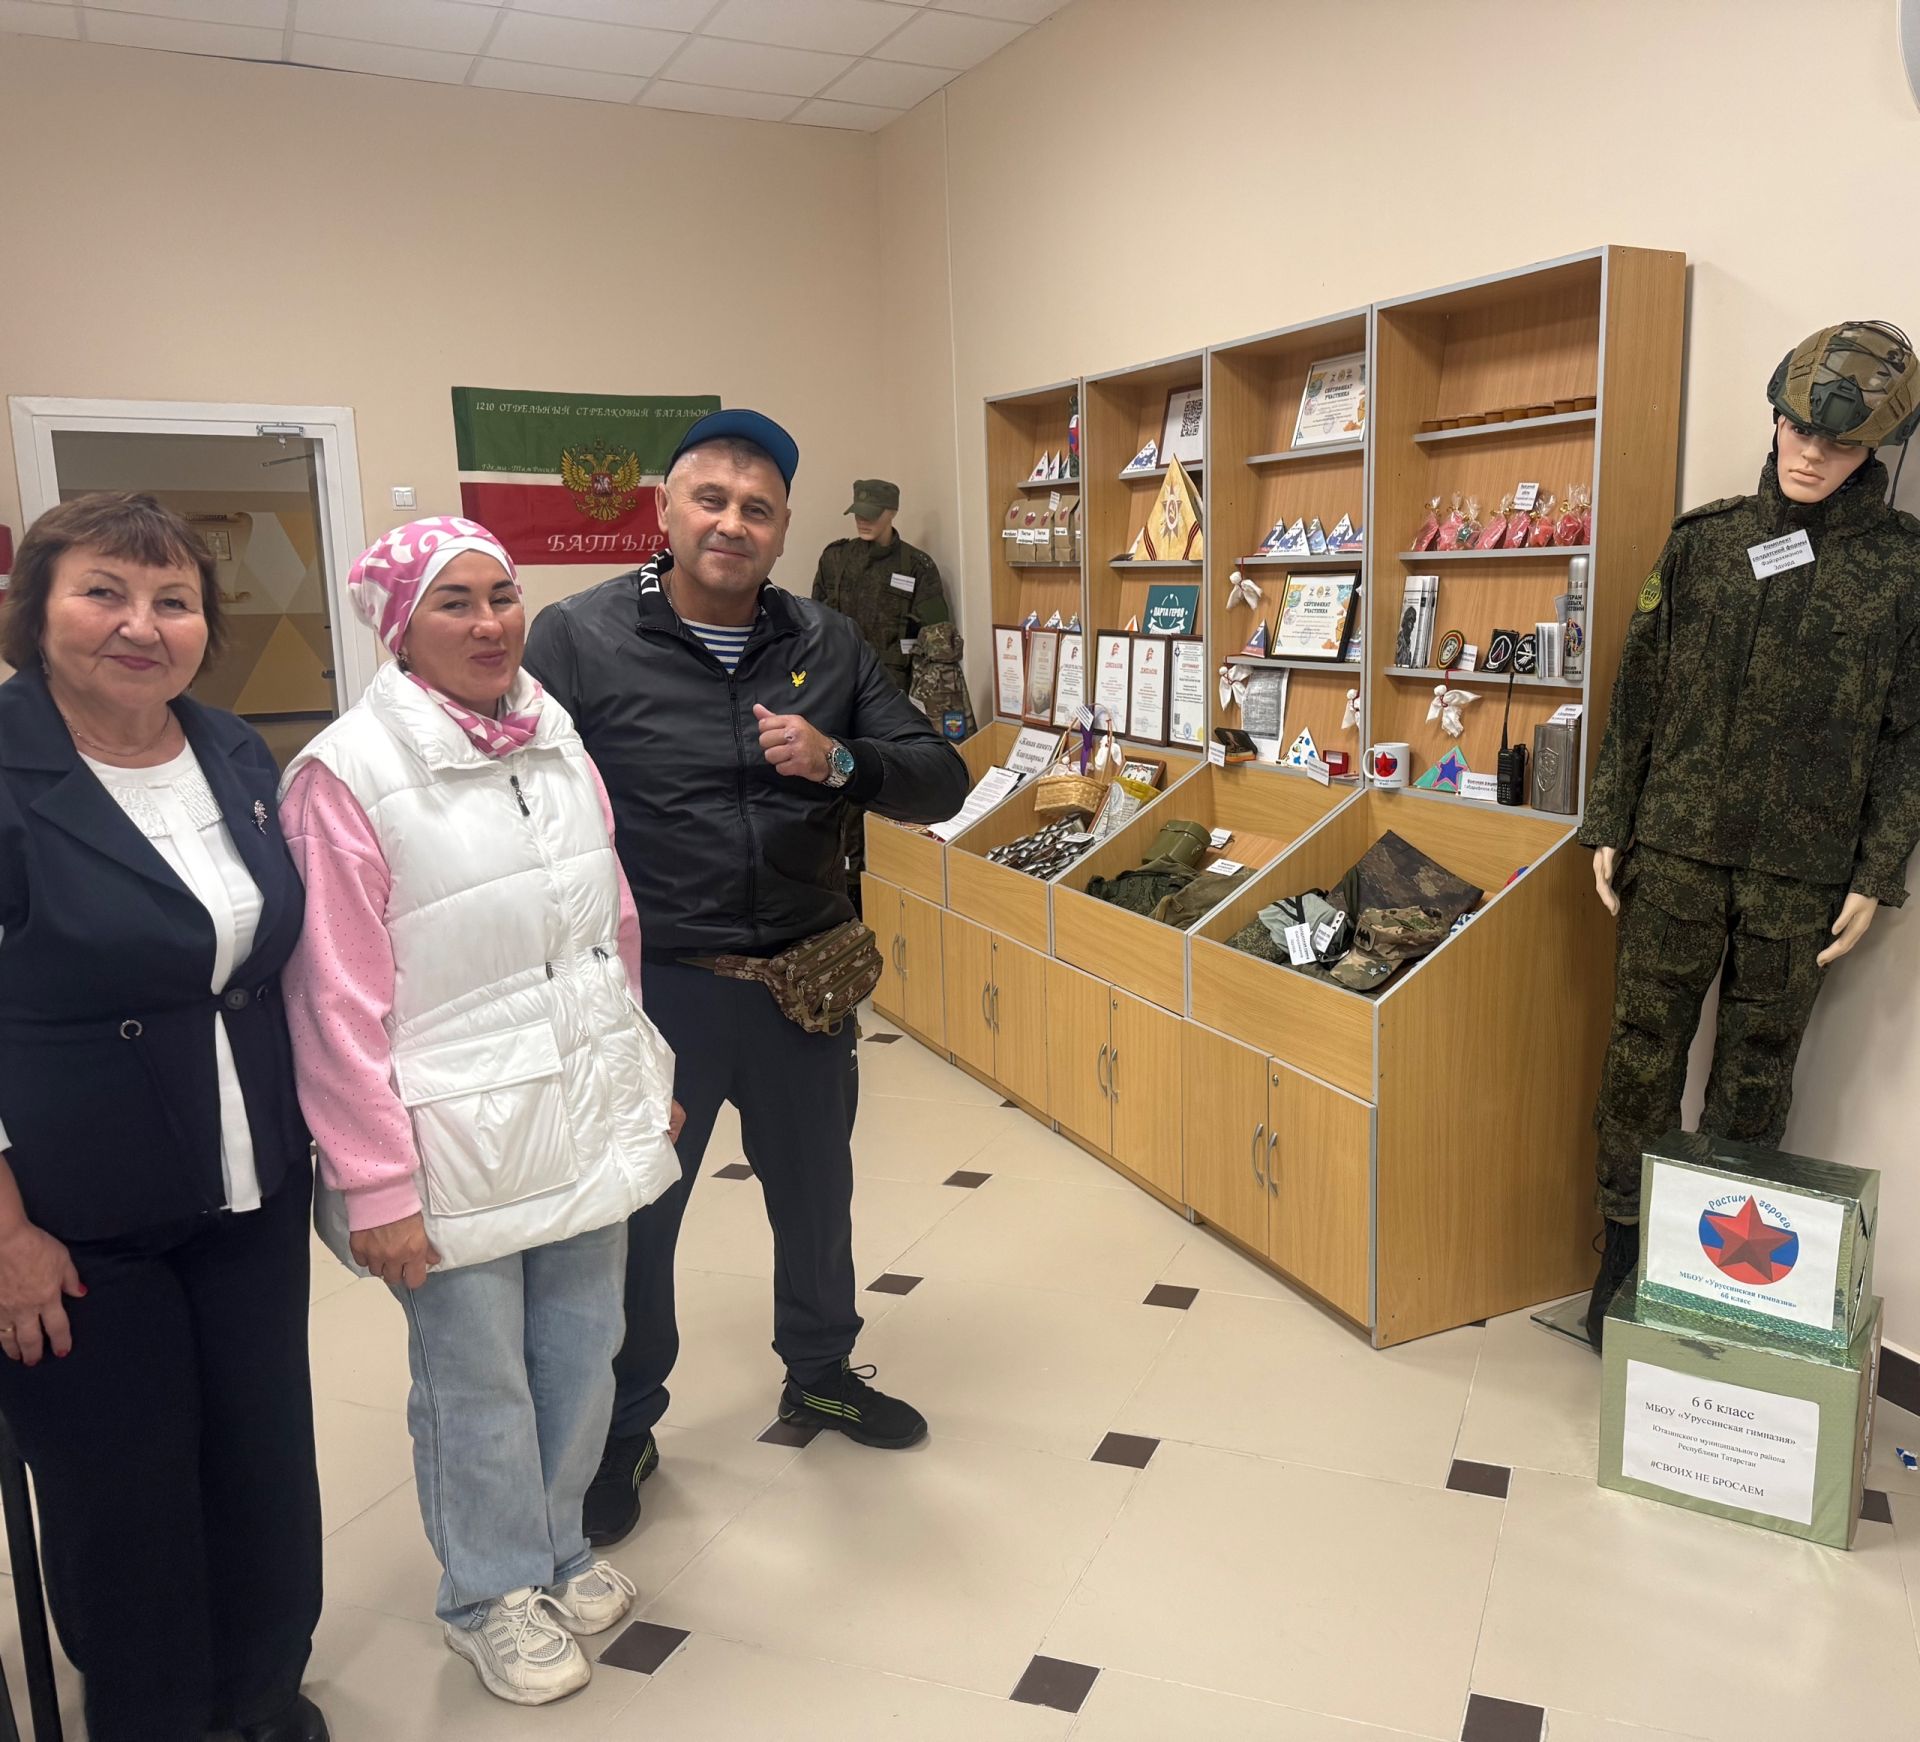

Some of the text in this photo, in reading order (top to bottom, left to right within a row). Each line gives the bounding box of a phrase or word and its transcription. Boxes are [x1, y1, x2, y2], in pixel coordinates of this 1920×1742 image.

[476, 402, 495, 411] 1210
[500, 403, 570, 415] ОТДЕЛЬНЫЙ
[576, 407, 649, 418] СТРЕЛКОВЫЙ
[547, 533, 664, 552] БАТЫР
[1708, 1194, 1747, 1210] Растим
[1679, 1271, 1797, 1308] МБОУ «Уруссинская гимназия»
[1730, 1296, 1751, 1305] класс
[1691, 1396, 1756, 1420] 6 б класс
[1644, 1401, 1796, 1445] МБОУ «Уруссинская гимназия»
[1652, 1424, 1786, 1464] Ютазинского муниципального района
[1678, 1442, 1756, 1468] Республики Татарстан
[1650, 1460, 1764, 1497] #СВОИХ НЕ БРОСАЕМ
